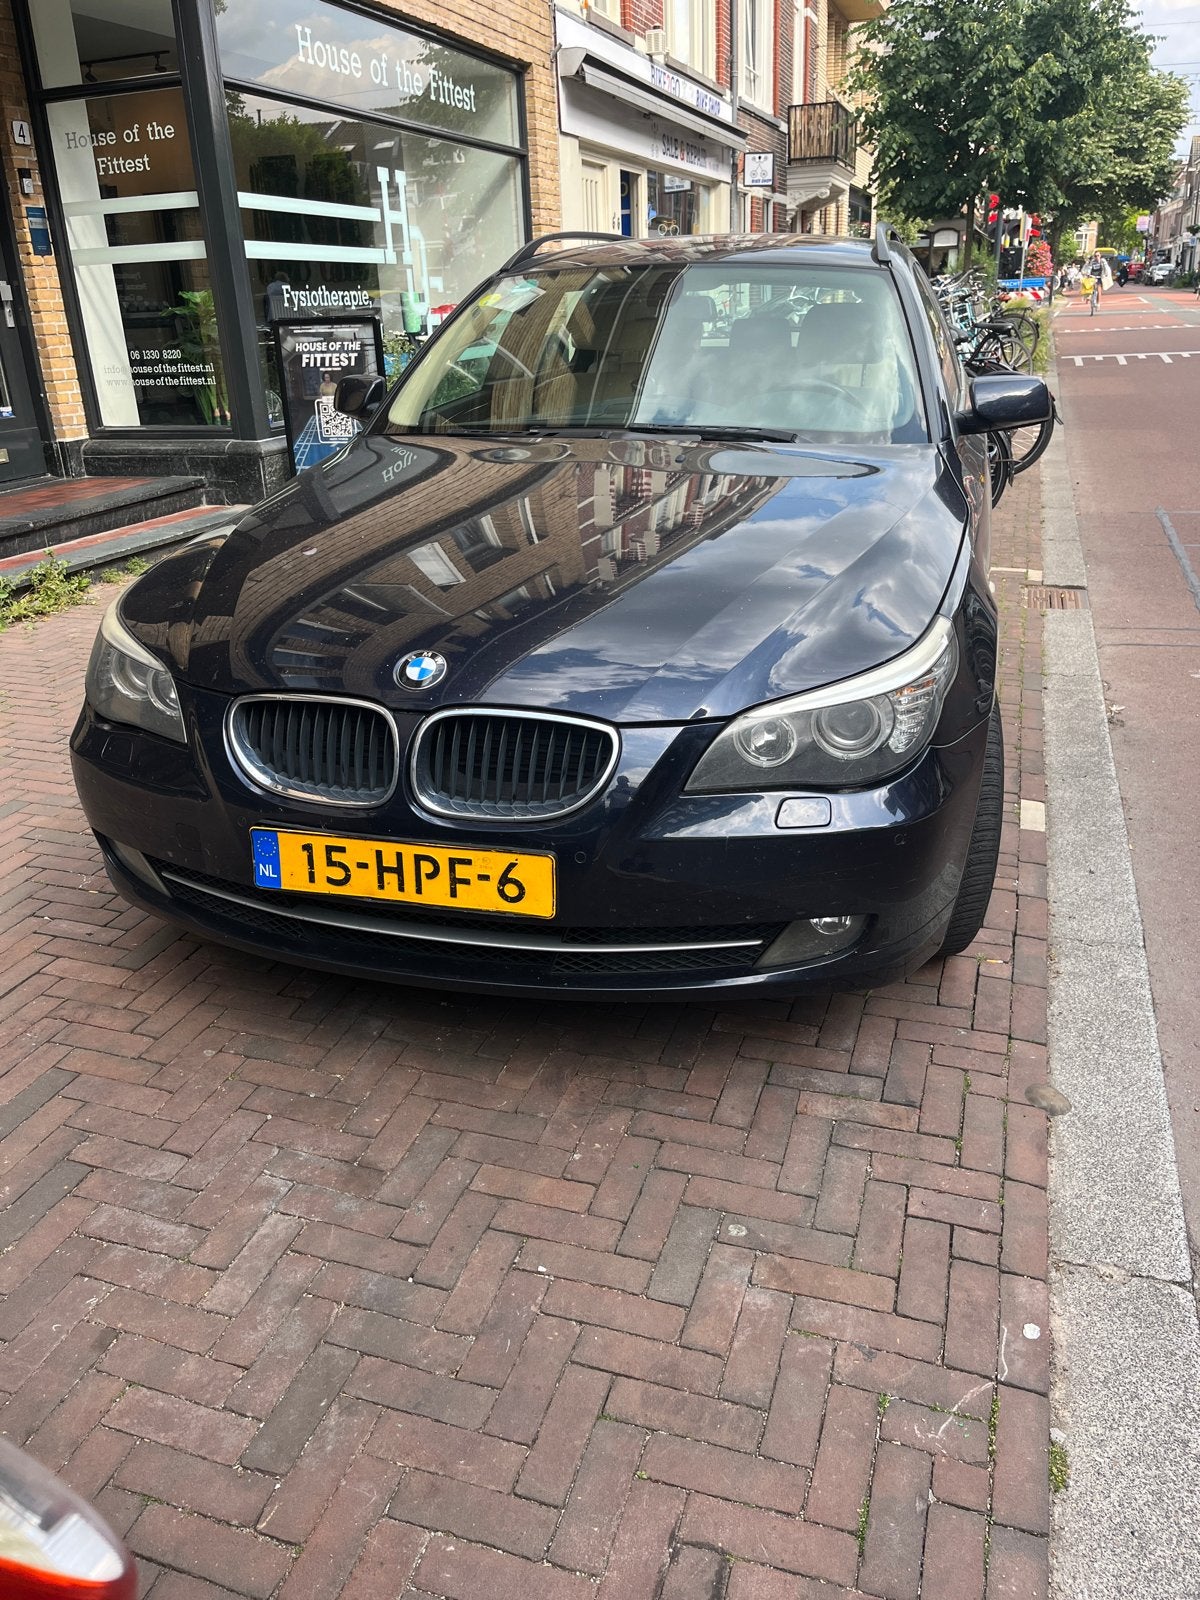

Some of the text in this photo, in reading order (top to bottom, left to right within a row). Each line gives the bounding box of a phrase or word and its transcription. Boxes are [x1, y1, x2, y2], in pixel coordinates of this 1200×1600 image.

[295, 24, 476, 112] House of the Fittest
[18, 123, 26, 142] 4
[65, 122, 175, 149] House of the
[662, 133, 679, 159] SALE
[97, 154, 151, 176] Fittest
[282, 284, 372, 311] Fysiotherapie,
[130, 349, 181, 360] 06 1330 8220
[295, 341, 361, 352] HOUSE OF THE
[302, 353, 358, 368] FITTEST
[259, 843, 526, 904] NL 15-HPF-6
